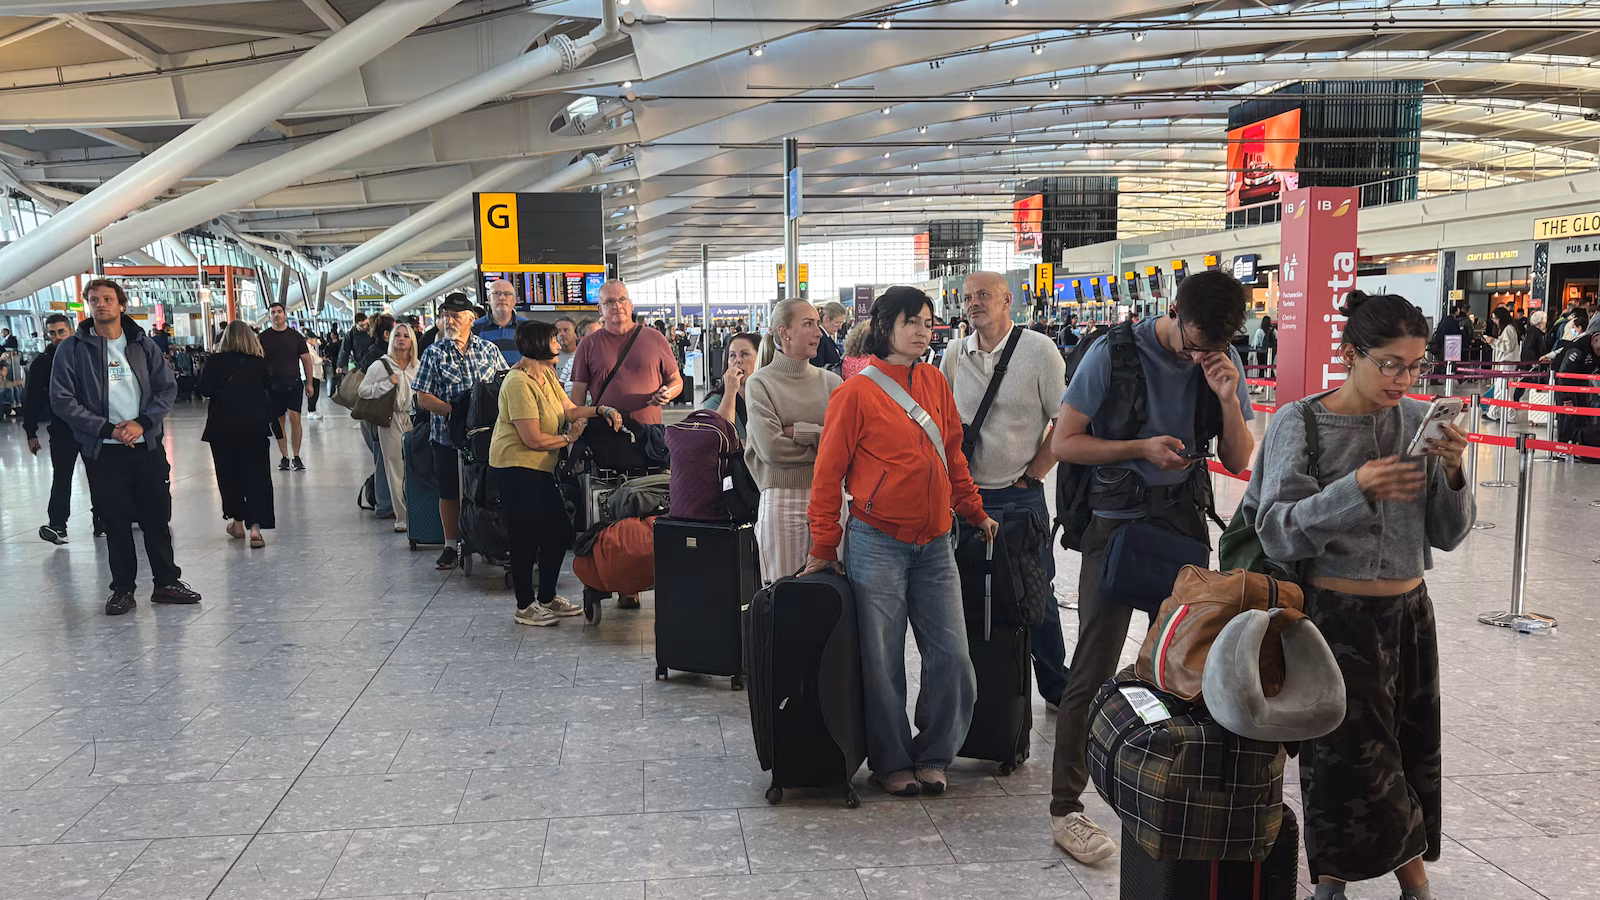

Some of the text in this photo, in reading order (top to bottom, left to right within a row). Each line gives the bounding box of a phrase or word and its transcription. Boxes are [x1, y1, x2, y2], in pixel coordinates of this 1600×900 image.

[1285, 203, 1294, 214] IB
[1317, 200, 1332, 211] IB
[487, 204, 510, 229] G
[1542, 219, 1568, 236] THE
[1566, 244, 1582, 254] PUB
[1584, 244, 1590, 252] &
[1041, 268, 1048, 279] E
[1281, 322, 1297, 331] Economy
